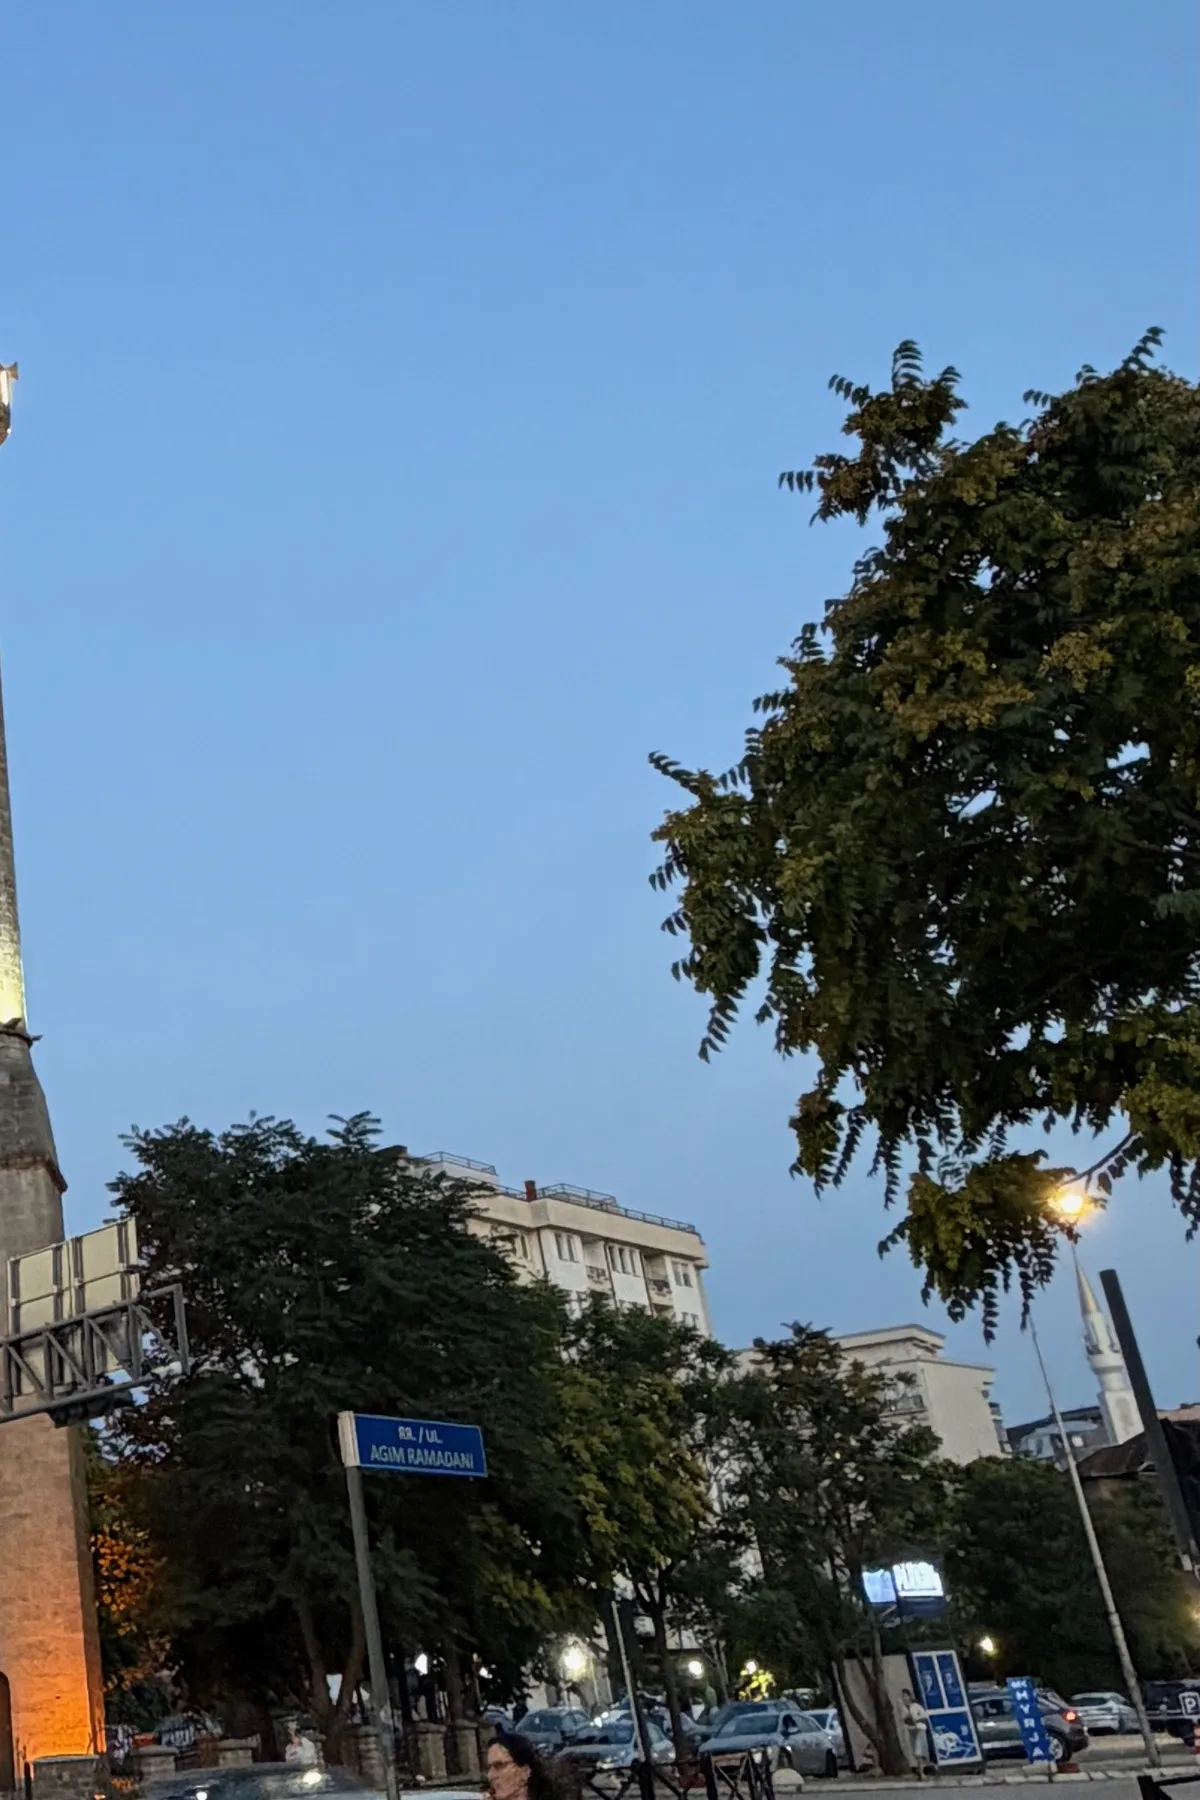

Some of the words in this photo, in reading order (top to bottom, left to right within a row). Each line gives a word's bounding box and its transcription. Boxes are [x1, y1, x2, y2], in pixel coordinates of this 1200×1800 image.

[425, 1428, 443, 1444] UL.
[370, 1444, 405, 1464] AGIM
[407, 1447, 474, 1469] RAMADANI
